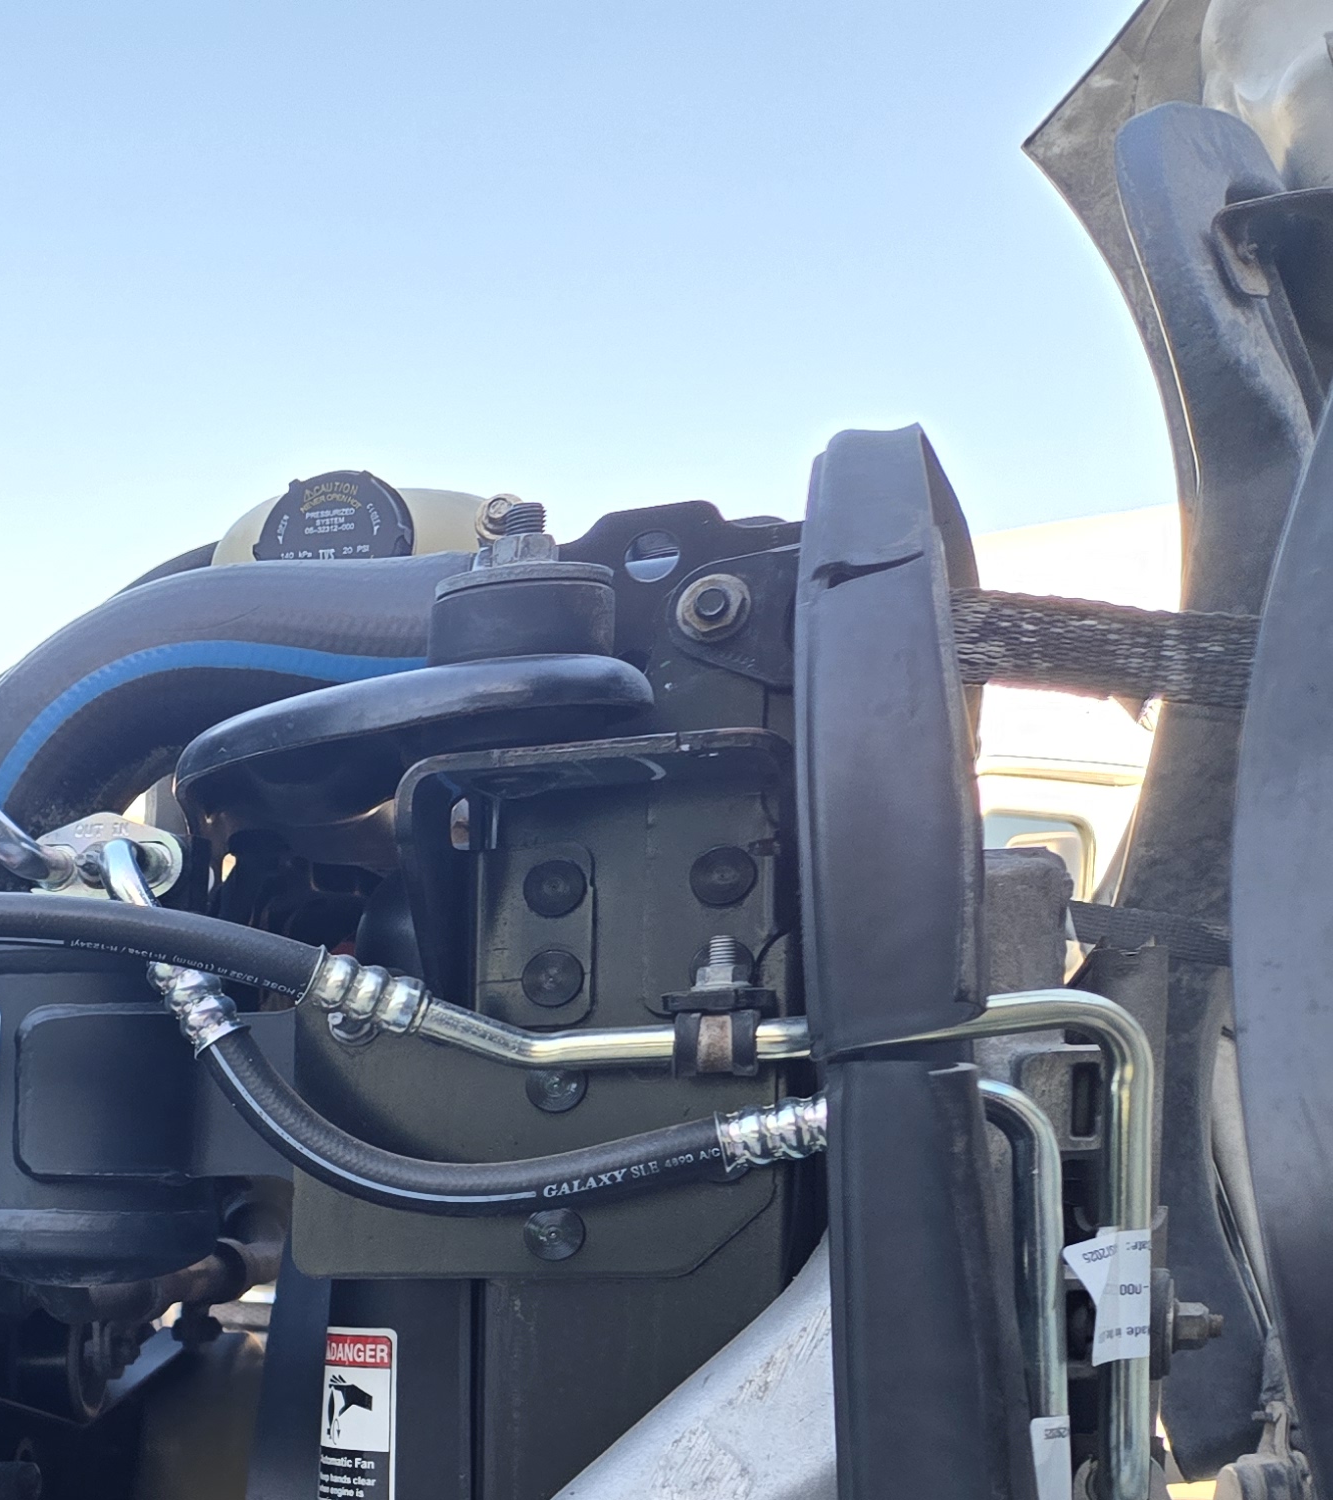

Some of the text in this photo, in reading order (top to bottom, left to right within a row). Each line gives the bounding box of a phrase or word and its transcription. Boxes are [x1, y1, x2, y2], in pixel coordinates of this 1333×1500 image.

[313, 481, 359, 497] CAUTION
[305, 507, 356, 519] PRESSURIZED
[316, 517, 345, 526] SYSTEM
[357, 545, 370, 554] PSI
[263, 979, 296, 995] HOSE
[543, 1168, 627, 1198] GALAXY
[630, 1161, 660, 1179] SLE
[699, 1147, 721, 1160] A/C
[331, 1342, 388, 1363] DANGER
[354, 1458, 375, 1470] Fan
[330, 1473, 351, 1484] hands
[352, 1476, 376, 1486] clear
[330, 1486, 354, 1498] engine
[355, 1488, 364, 1498] is
